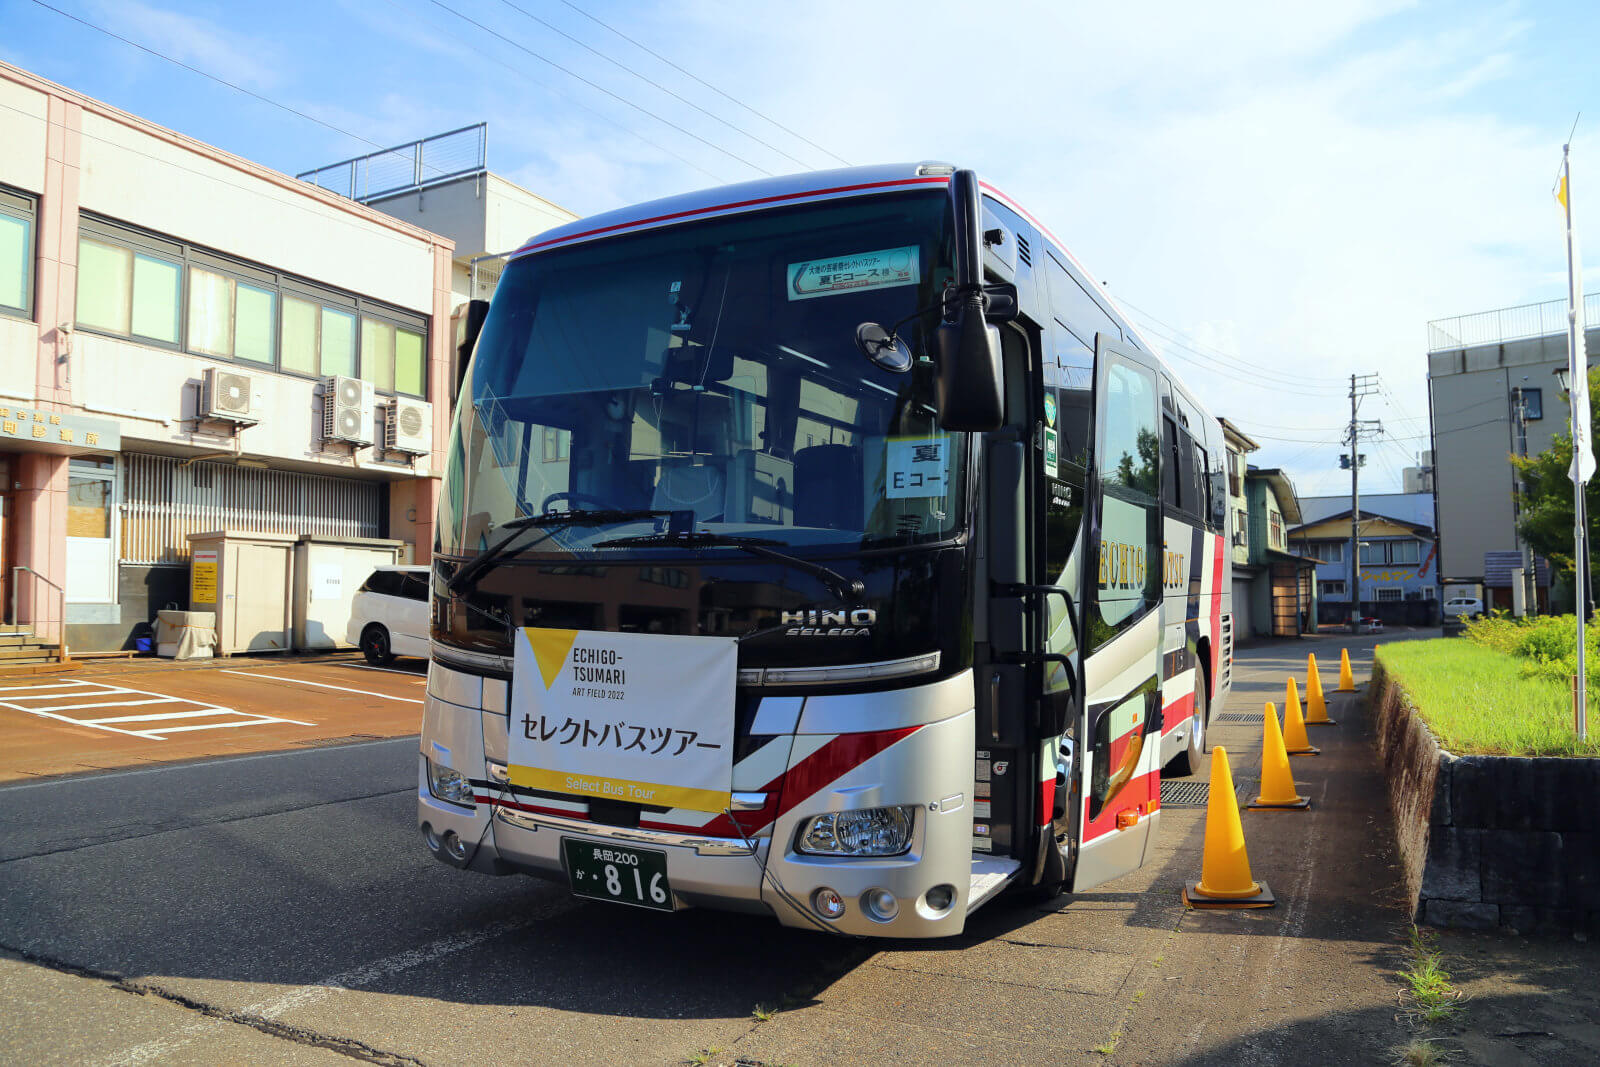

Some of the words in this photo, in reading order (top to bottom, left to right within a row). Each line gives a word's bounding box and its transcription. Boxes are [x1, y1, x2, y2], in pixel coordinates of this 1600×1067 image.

[912, 444, 942, 463] 夏
[781, 609, 877, 625] HINO
[786, 627, 871, 637] SELEGA
[573, 647, 624, 666] ECHIGO-
[573, 666, 626, 685] TSUMARI
[572, 687, 585, 697] ART
[587, 688, 606, 699] FIELD
[607, 690, 625, 701] 2022
[520, 712, 722, 757] セレクトバスツアー
[565, 776, 600, 794] Select
[602, 781, 625, 797] Bus
[627, 784, 656, 801] Tour
[593, 848, 639, 866] 長岡200
[576, 868, 585, 880] か
